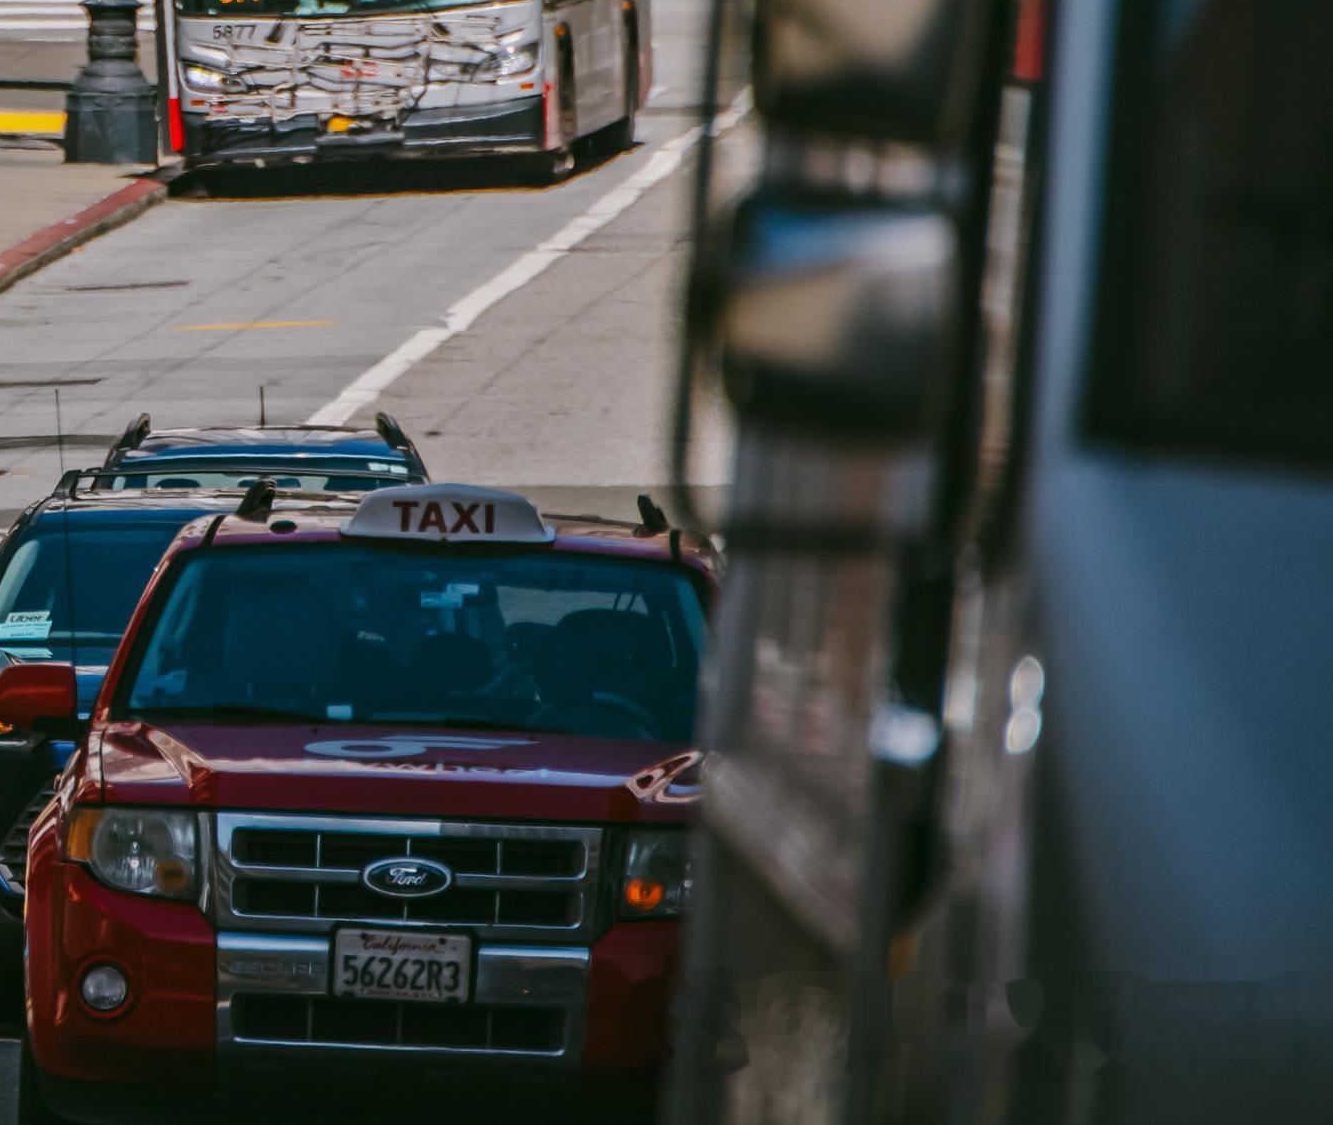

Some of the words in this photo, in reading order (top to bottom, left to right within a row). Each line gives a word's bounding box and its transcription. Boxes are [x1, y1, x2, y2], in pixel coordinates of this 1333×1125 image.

[212, 24, 257, 41] 5877
[392, 500, 495, 534] TAXI
[10, 614, 43, 623] Uber
[388, 866, 427, 886] Ford
[362, 933, 438, 956] California
[342, 954, 461, 992] 56262R3
